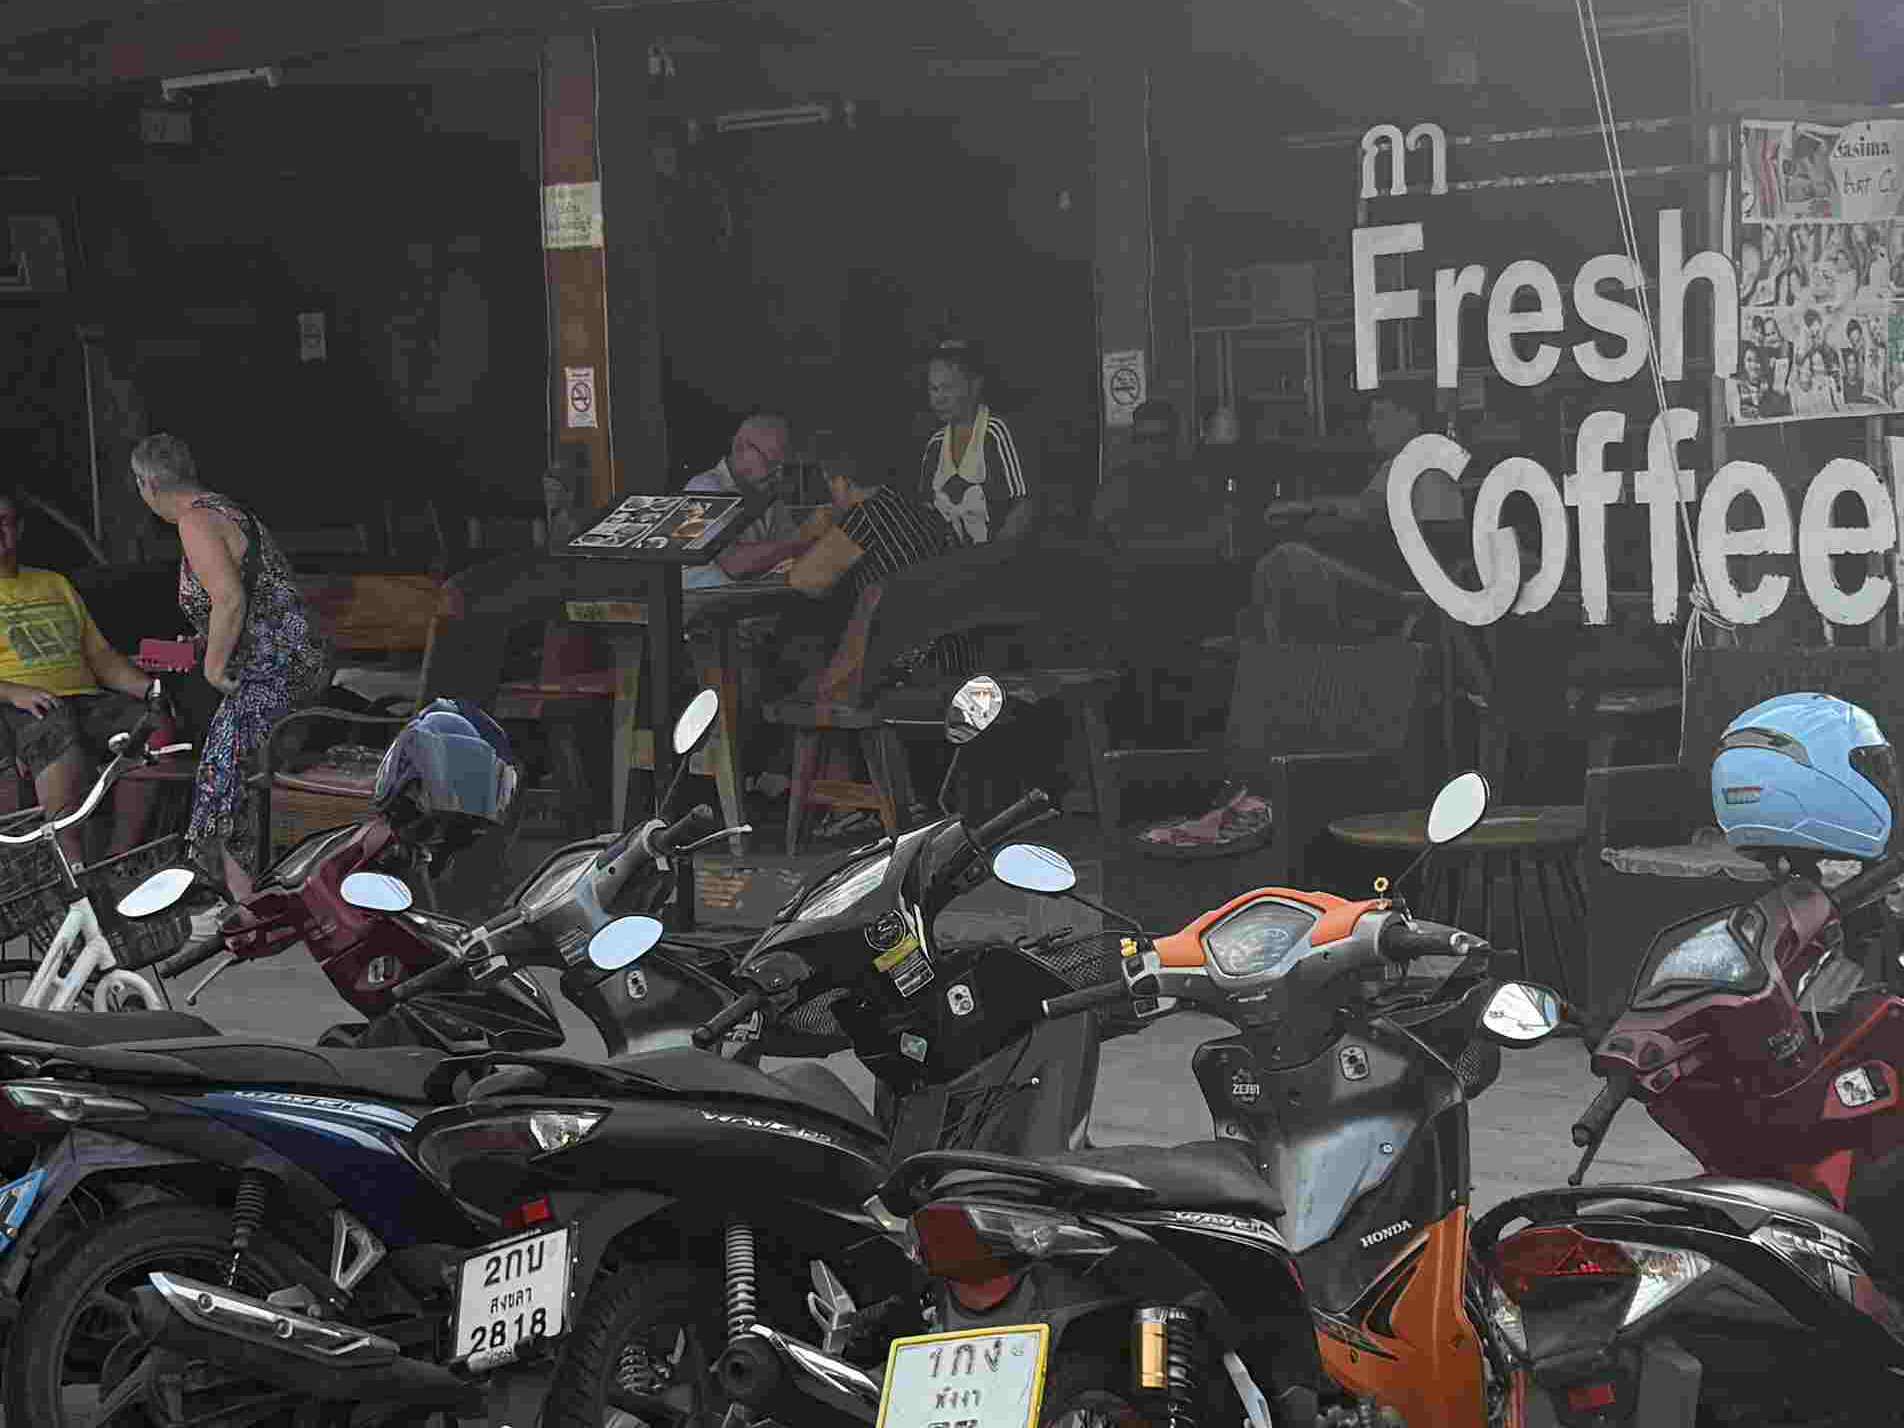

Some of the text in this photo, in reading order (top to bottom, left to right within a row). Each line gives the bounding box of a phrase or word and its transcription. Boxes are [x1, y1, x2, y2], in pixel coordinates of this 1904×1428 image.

[1350, 208, 1739, 392] Fresh
[1385, 407, 1897, 628] Coffee
[1359, 1219, 1413, 1248] HONDA
[470, 1307, 547, 1355] 2818
